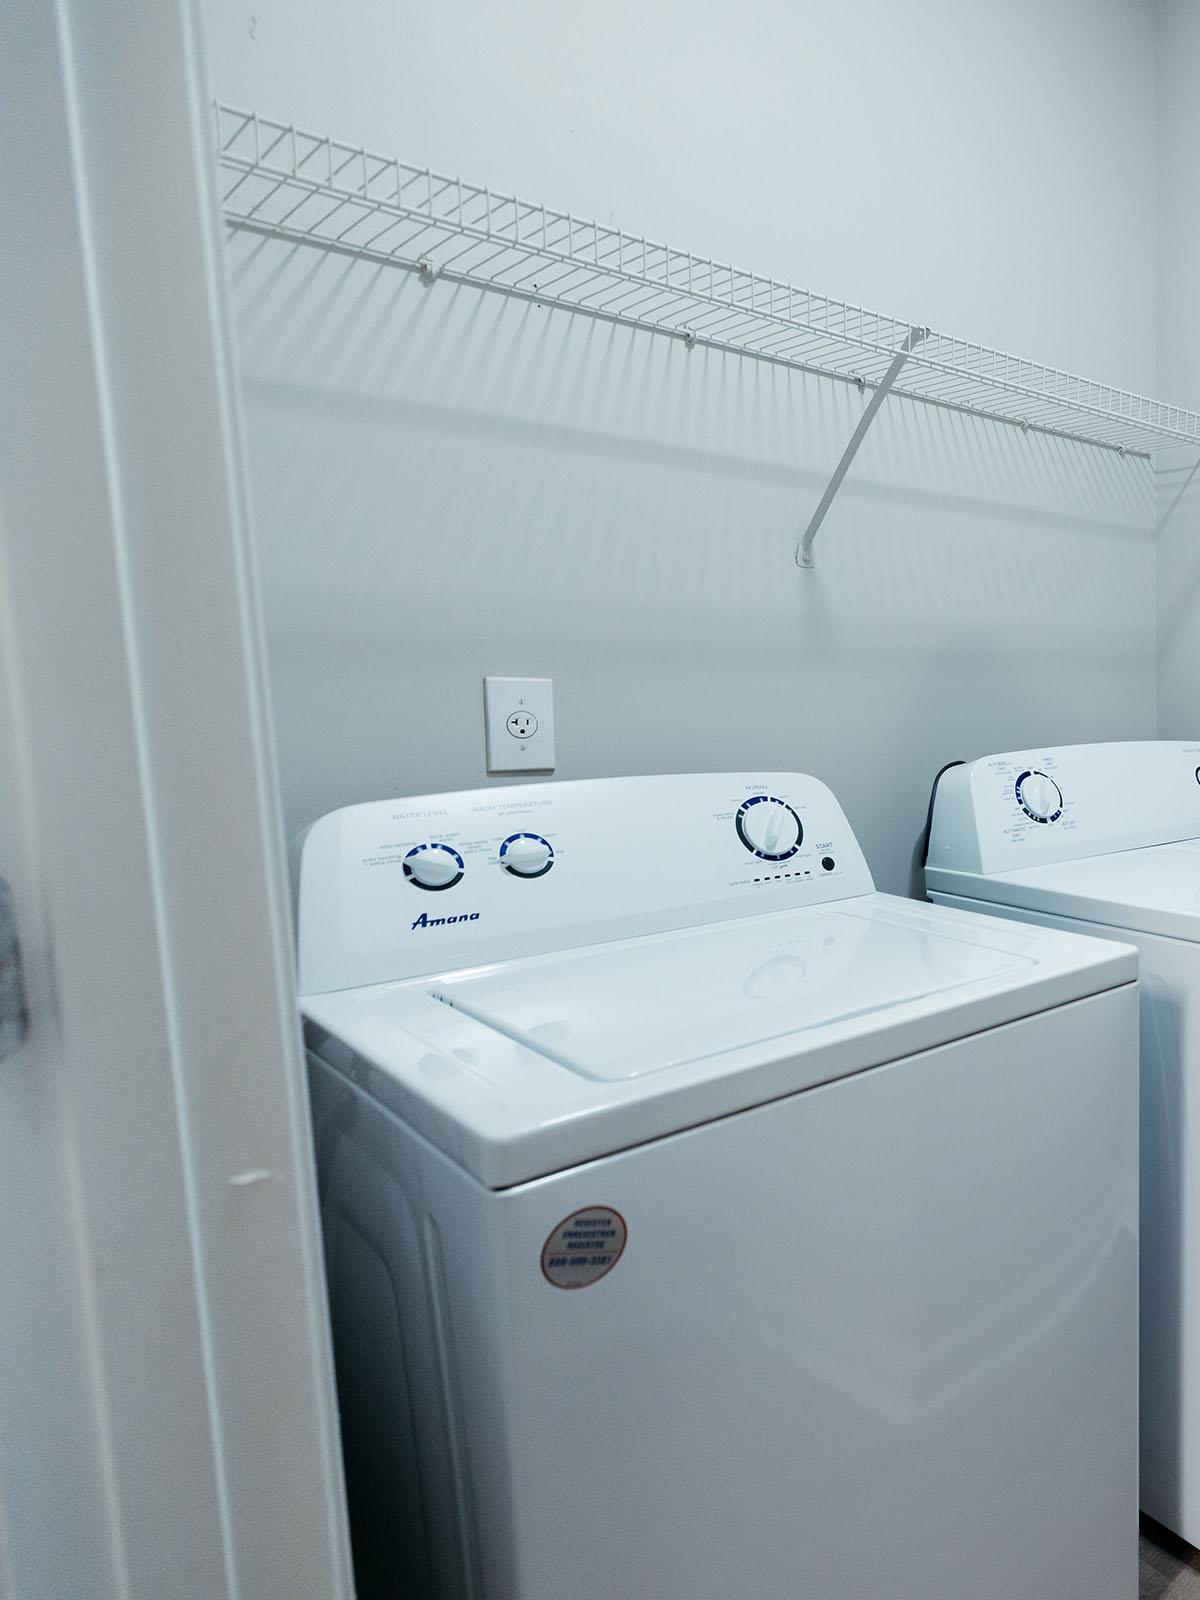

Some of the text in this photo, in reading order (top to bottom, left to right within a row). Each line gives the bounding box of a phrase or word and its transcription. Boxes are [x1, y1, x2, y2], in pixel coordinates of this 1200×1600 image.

[471, 804, 496, 813] WASH
[498, 800, 553, 812] TEMPERATURE
[391, 809, 449, 821] WATER LEVEL
[815, 842, 833, 850] START
[411, 912, 480, 930] Amana
